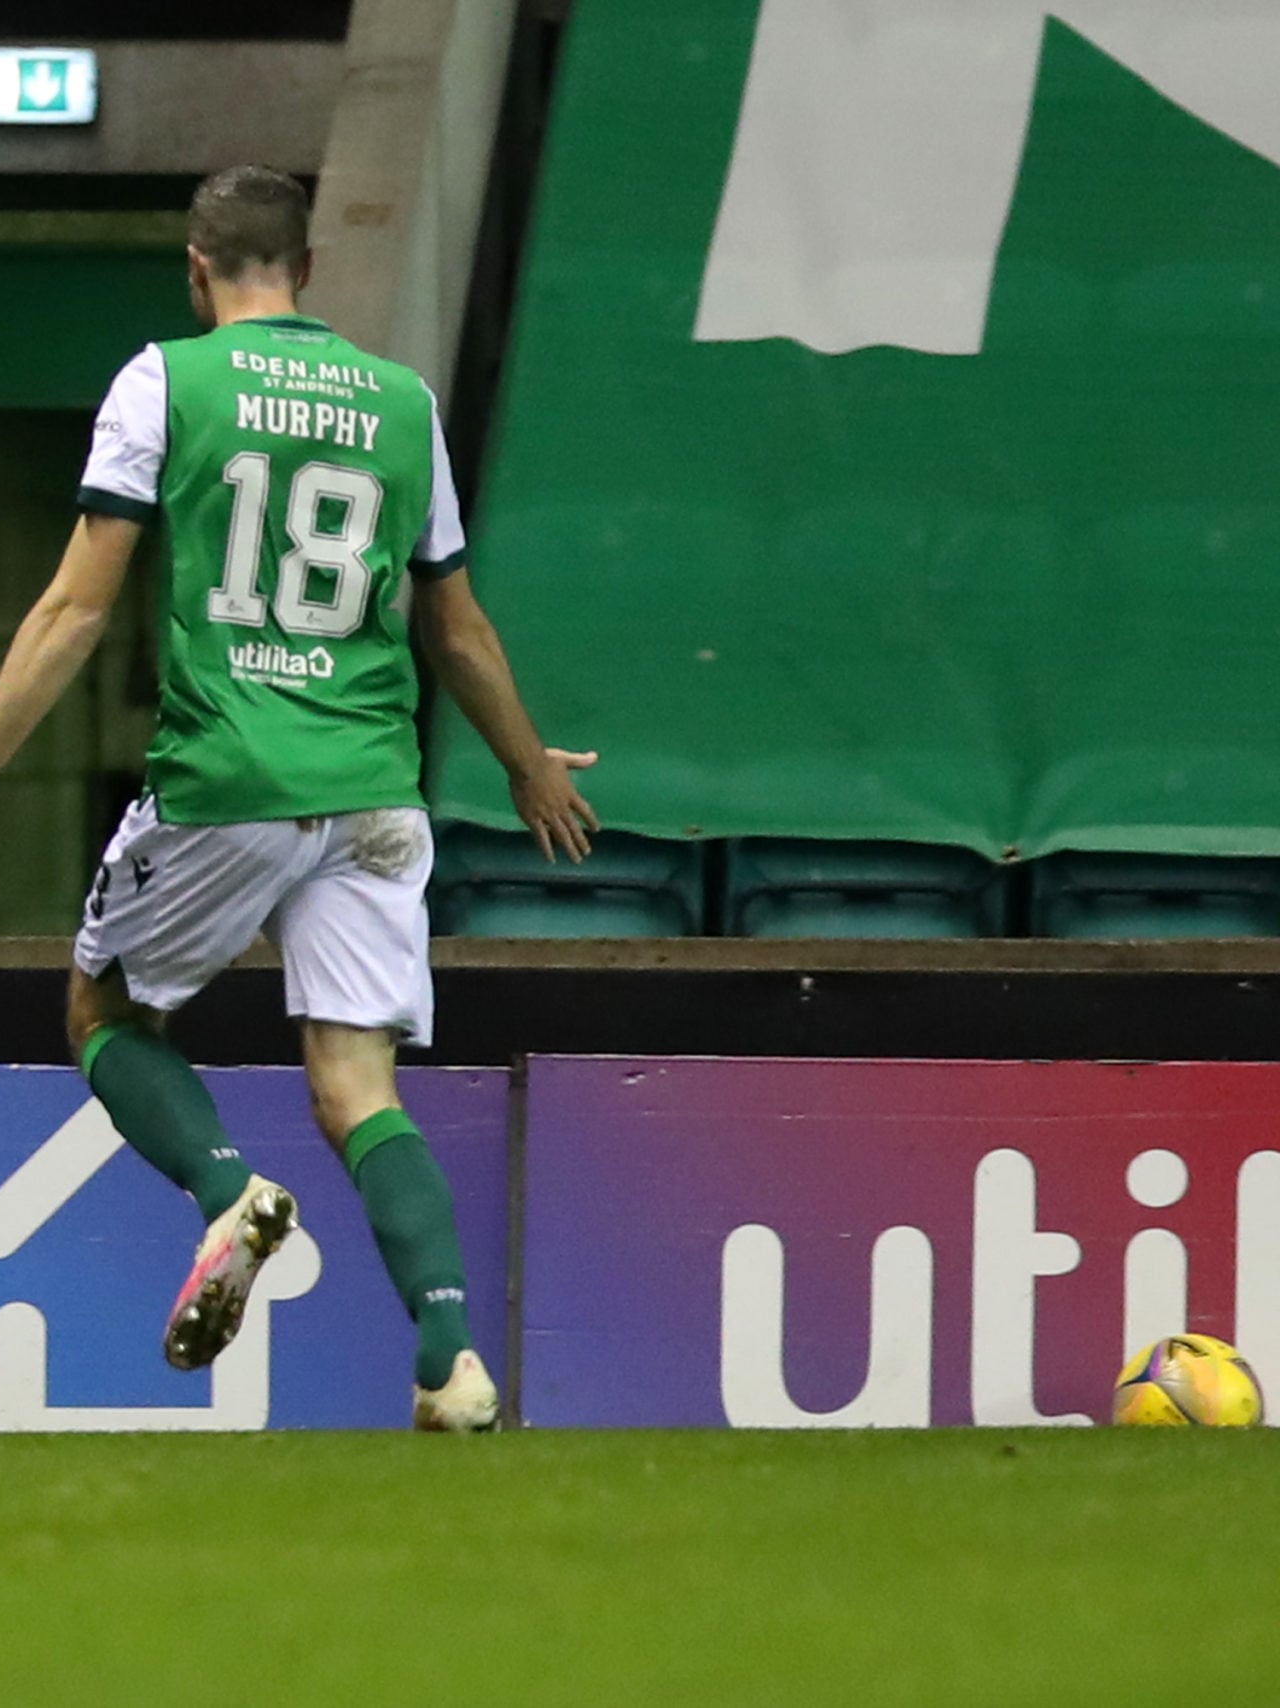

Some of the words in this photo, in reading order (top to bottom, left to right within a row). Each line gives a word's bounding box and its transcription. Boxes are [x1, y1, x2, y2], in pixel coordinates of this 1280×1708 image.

[263, 377, 281, 388] ST
[285, 379, 354, 399] ANDREWS
[237, 393, 381, 450] MURPHY
[208, 451, 384, 639] 18
[228, 642, 308, 676] utilita
